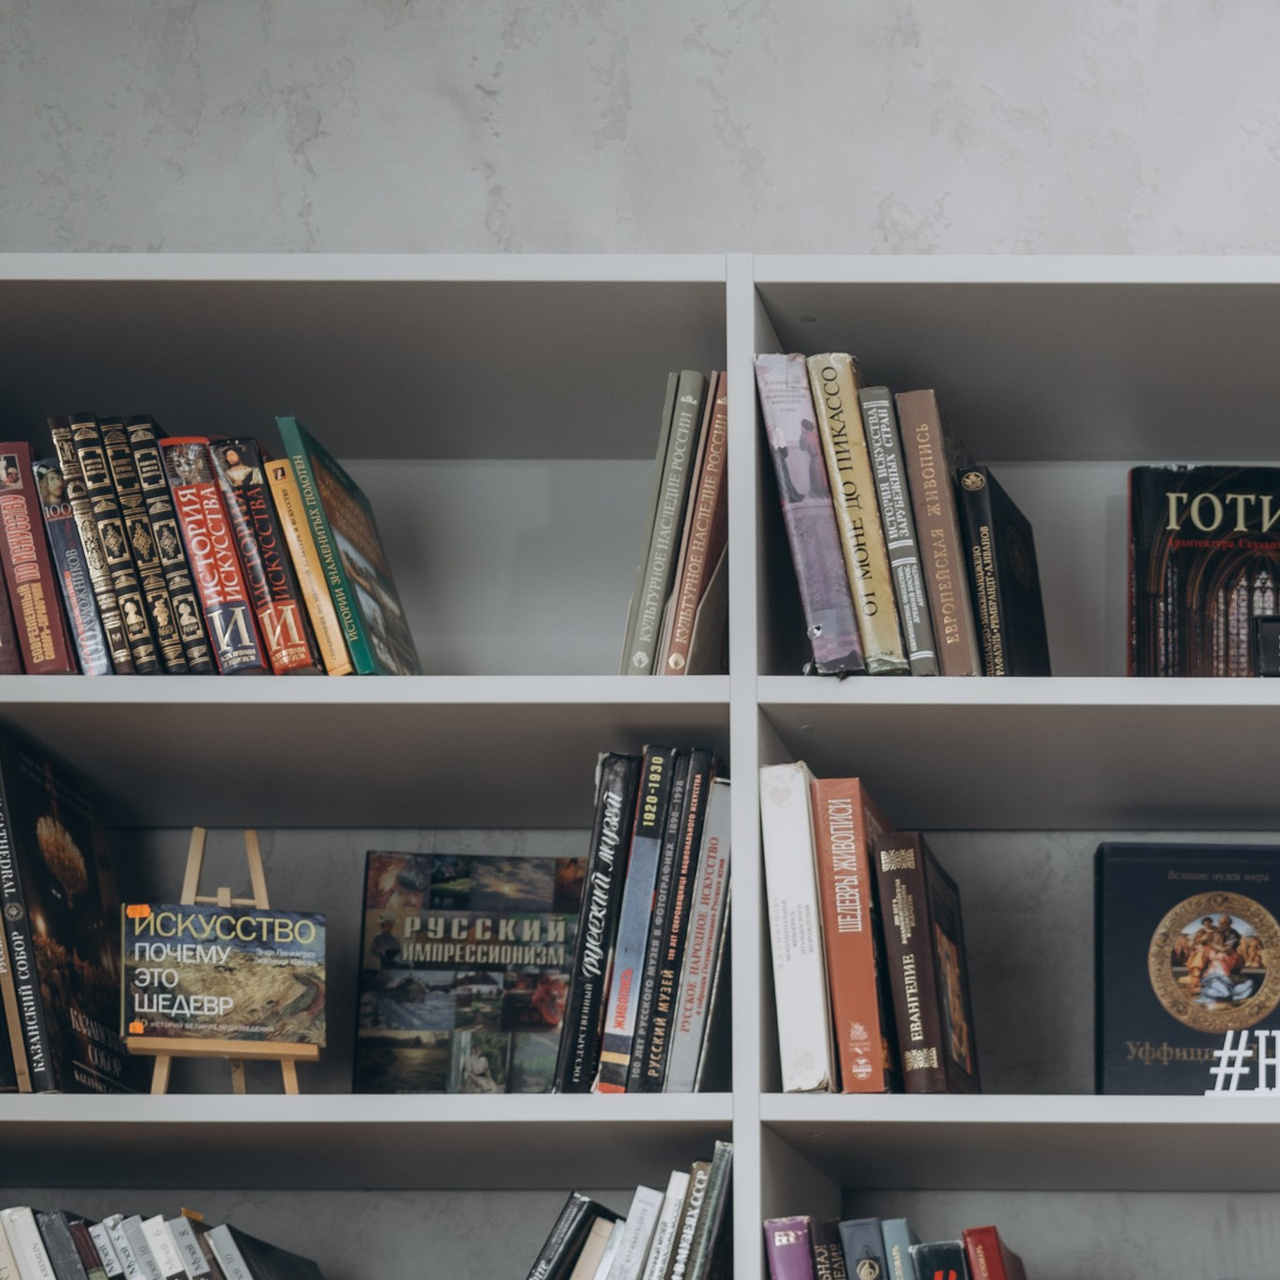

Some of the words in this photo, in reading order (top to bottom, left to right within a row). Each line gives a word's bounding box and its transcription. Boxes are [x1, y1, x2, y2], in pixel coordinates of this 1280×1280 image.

[819, 365, 853, 473] ПИКАССО
[864, 407, 888, 477] ИСКУССТВА
[878, 408, 894, 448] СТРАН
[292, 456, 316, 506] ПОЛОТЕН
[840, 479, 862, 512] ДО
[885, 453, 909, 537] ЗАРУБЕЖНЫХ
[914, 422, 940, 516] ЖИВОПИСЬ
[0, 492, 36, 565] ИСКУССТВУ
[637, 551, 669, 642] КУЛЬТУРНОЕ
[654, 472, 684, 549] НАСЛЕДИЕ
[669, 411, 694, 470] РОССИИ
[671, 554, 705, 644] КУЛЬТУРНОЕ
[689, 473, 719, 551] НАСЛЕДИЕ
[704, 412, 731, 472] РОССИИ
[879, 482, 899, 539] ИСТОРИЯ
[1168, 536, 1234, 550] Архитектура
[12, 561, 40, 583] ПО
[177, 487, 224, 607] ИСТОРИЯ
[199, 486, 243, 602] ИСКУССТВА
[226, 489, 271, 608] ИСТОРИЯ
[245, 486, 291, 602] ИСКУССТВА
[308, 507, 341, 586] ЗНАМЕНИТЫХ
[848, 517, 872, 581] МОНЕ
[63, 548, 96, 633] ХУДОЖНИКОВ
[333, 588, 358, 641] ИСТОРИИ
[861, 591, 878, 617] ОТ
[929, 528, 959, 644] ЕВРОПЕЙСКАЯ
[16, 584, 45, 663] СОВРЕМЕННЫЙ
[641, 755, 664, 827] 1920-1930
[826, 797, 858, 872] ЖИВОПИСИ
[698, 836, 719, 905] ИСКУССТВО
[833, 874, 863, 933] ШЕДЕВРЫ
[10, 930, 30, 979] СОБОР
[134, 912, 316, 944] ИСКУССТВО
[134, 942, 231, 964] ПОЧЕМУ
[402, 943, 565, 966] ИМПРЕССИОНИЗМ
[403, 915, 566, 942] РУССКИЙ
[688, 911, 708, 975] НАРОДНОЕ
[134, 968, 179, 988] ЭТО
[134, 993, 234, 1018] ШЕДЕВР
[612, 966, 633, 1030] ЖИВОПИСЬ
[654, 969, 674, 1012] МУЗЕЙ
[679, 980, 698, 1033] РУССКОЕ
[901, 953, 924, 1041] ЕВАНГЕЛИЕ
[17, 984, 45, 1072] КАЗАНСКИЙ
[570, 982, 594, 1082] ГОСУДАРСТВЕННЫЙ
[645, 1016, 667, 1077] РУССКИЙ
[676, 1207, 699, 1262] МУЗЕЯХ
[690, 1170, 708, 1207] СССР
